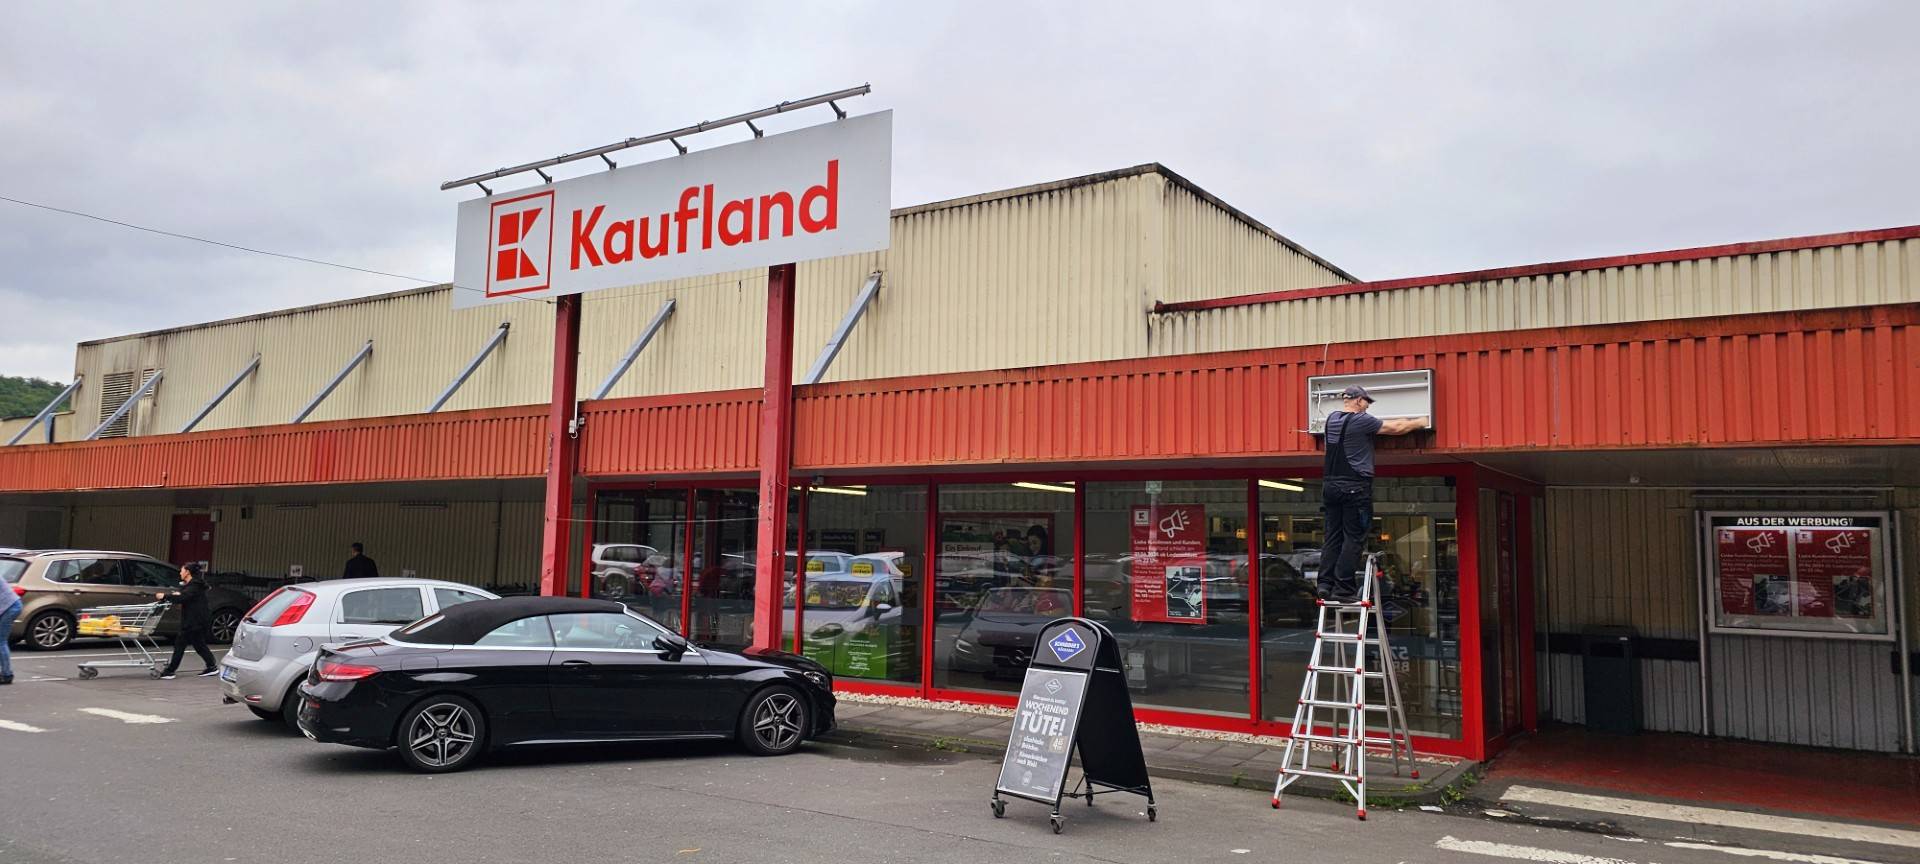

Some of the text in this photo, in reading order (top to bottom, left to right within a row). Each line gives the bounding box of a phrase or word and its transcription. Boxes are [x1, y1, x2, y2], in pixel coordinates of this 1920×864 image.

[570, 159, 838, 270] Kaufland
[1737, 518, 1759, 526] AUS
[1763, 518, 1784, 526] DER
[1026, 699, 1069, 715] WOCHENEND
[1020, 709, 1066, 737] TÜTE!
